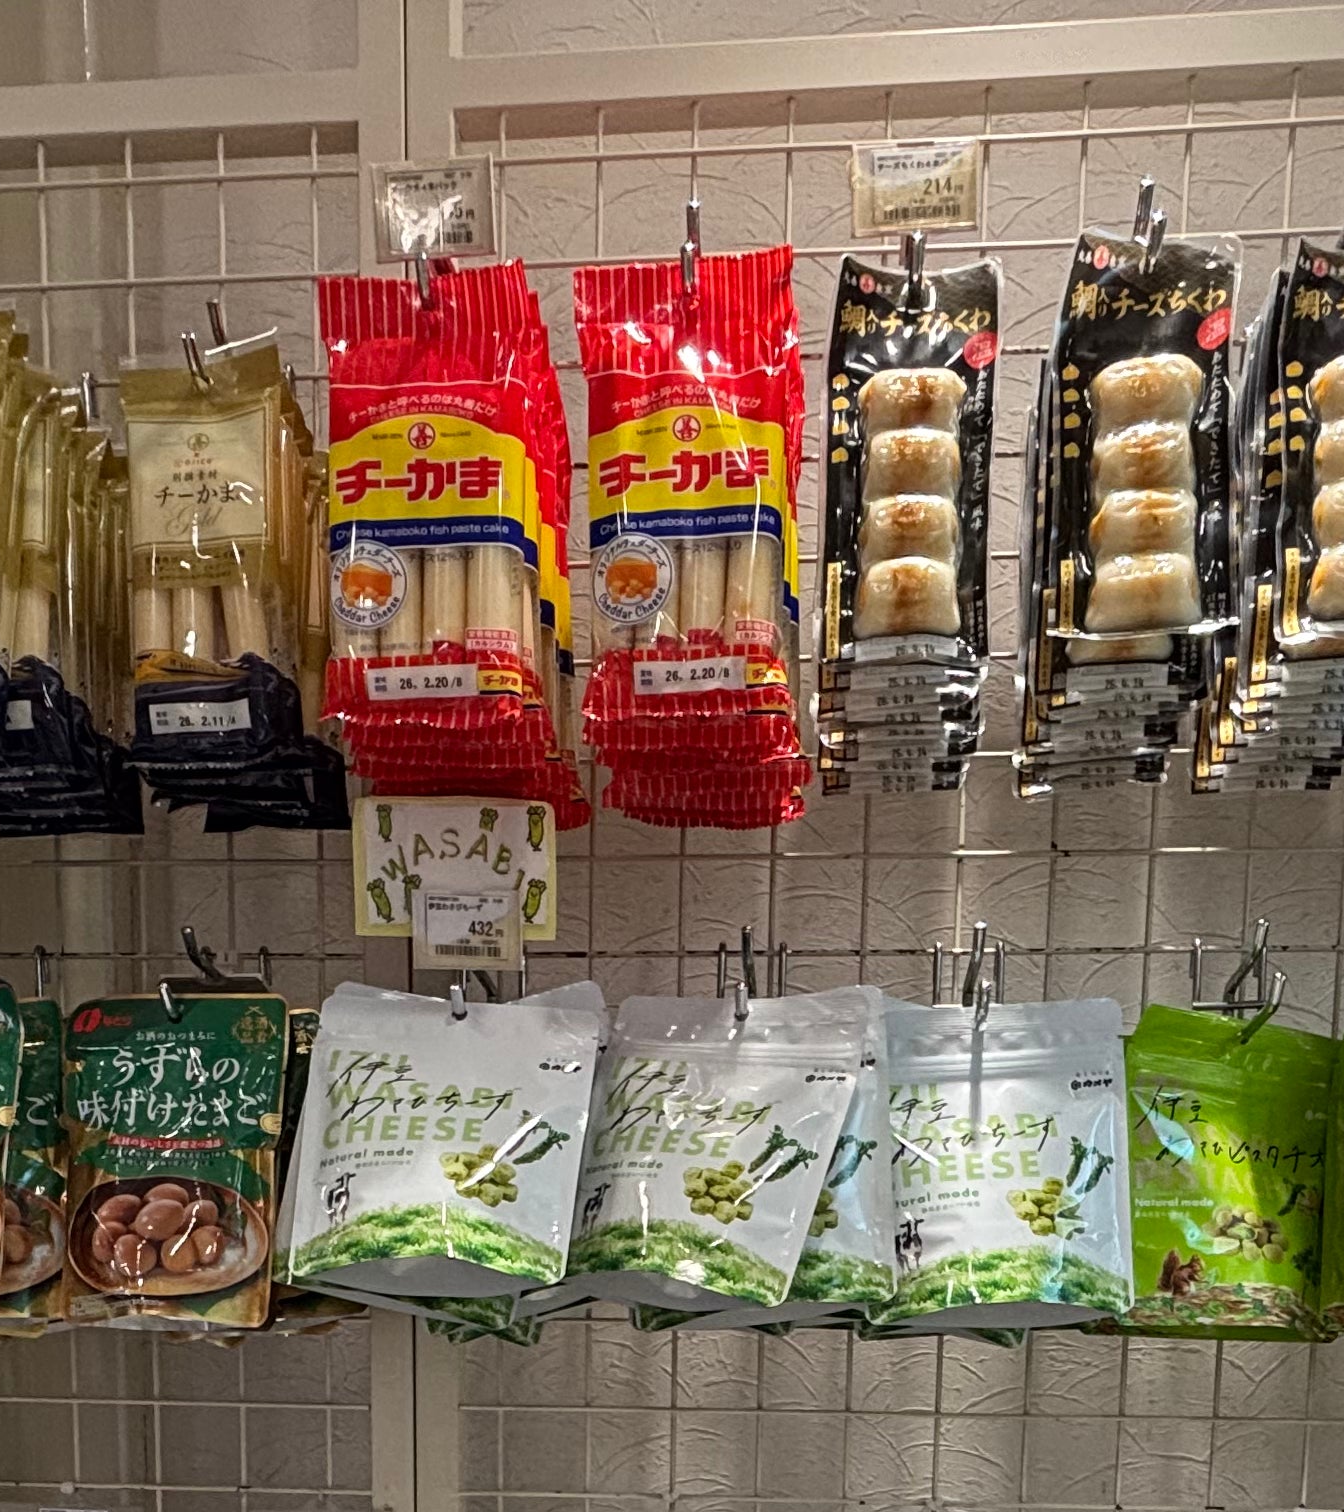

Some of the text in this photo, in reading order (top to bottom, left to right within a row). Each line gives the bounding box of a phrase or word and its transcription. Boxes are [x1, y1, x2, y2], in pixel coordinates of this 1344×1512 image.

[336, 456, 502, 505] チーかま
[599, 447, 769, 498] チーかま
[155, 483, 241, 505] チーかま
[336, 523, 509, 541] Chese kamaboko fish paste cake
[600, 520, 637, 536] Chese
[639, 517, 693, 530] kamaboko
[696, 515, 716, 527] fish
[718, 514, 748, 528] paste
[334, 596, 400, 623] Cheddar Cheese
[598, 586, 666, 620] Cheddar Cheese
[381, 828, 524, 891] WASABI
[136, 1031, 217, 1041] お酒のおつまみに
[112, 1045, 240, 1090] うずらの
[77, 1087, 267, 1129] 味付けたまご
[322, 1115, 484, 1150] CHEESE
[591, 1126, 734, 1159] CHEESE
[320, 1147, 414, 1168] Natural made
[630, 1158, 664, 1170] made
[900, 1149, 1041, 1188] HEESE
[937, 1188, 980, 1201] made
[1134, 1196, 1214, 1208] Natural made
